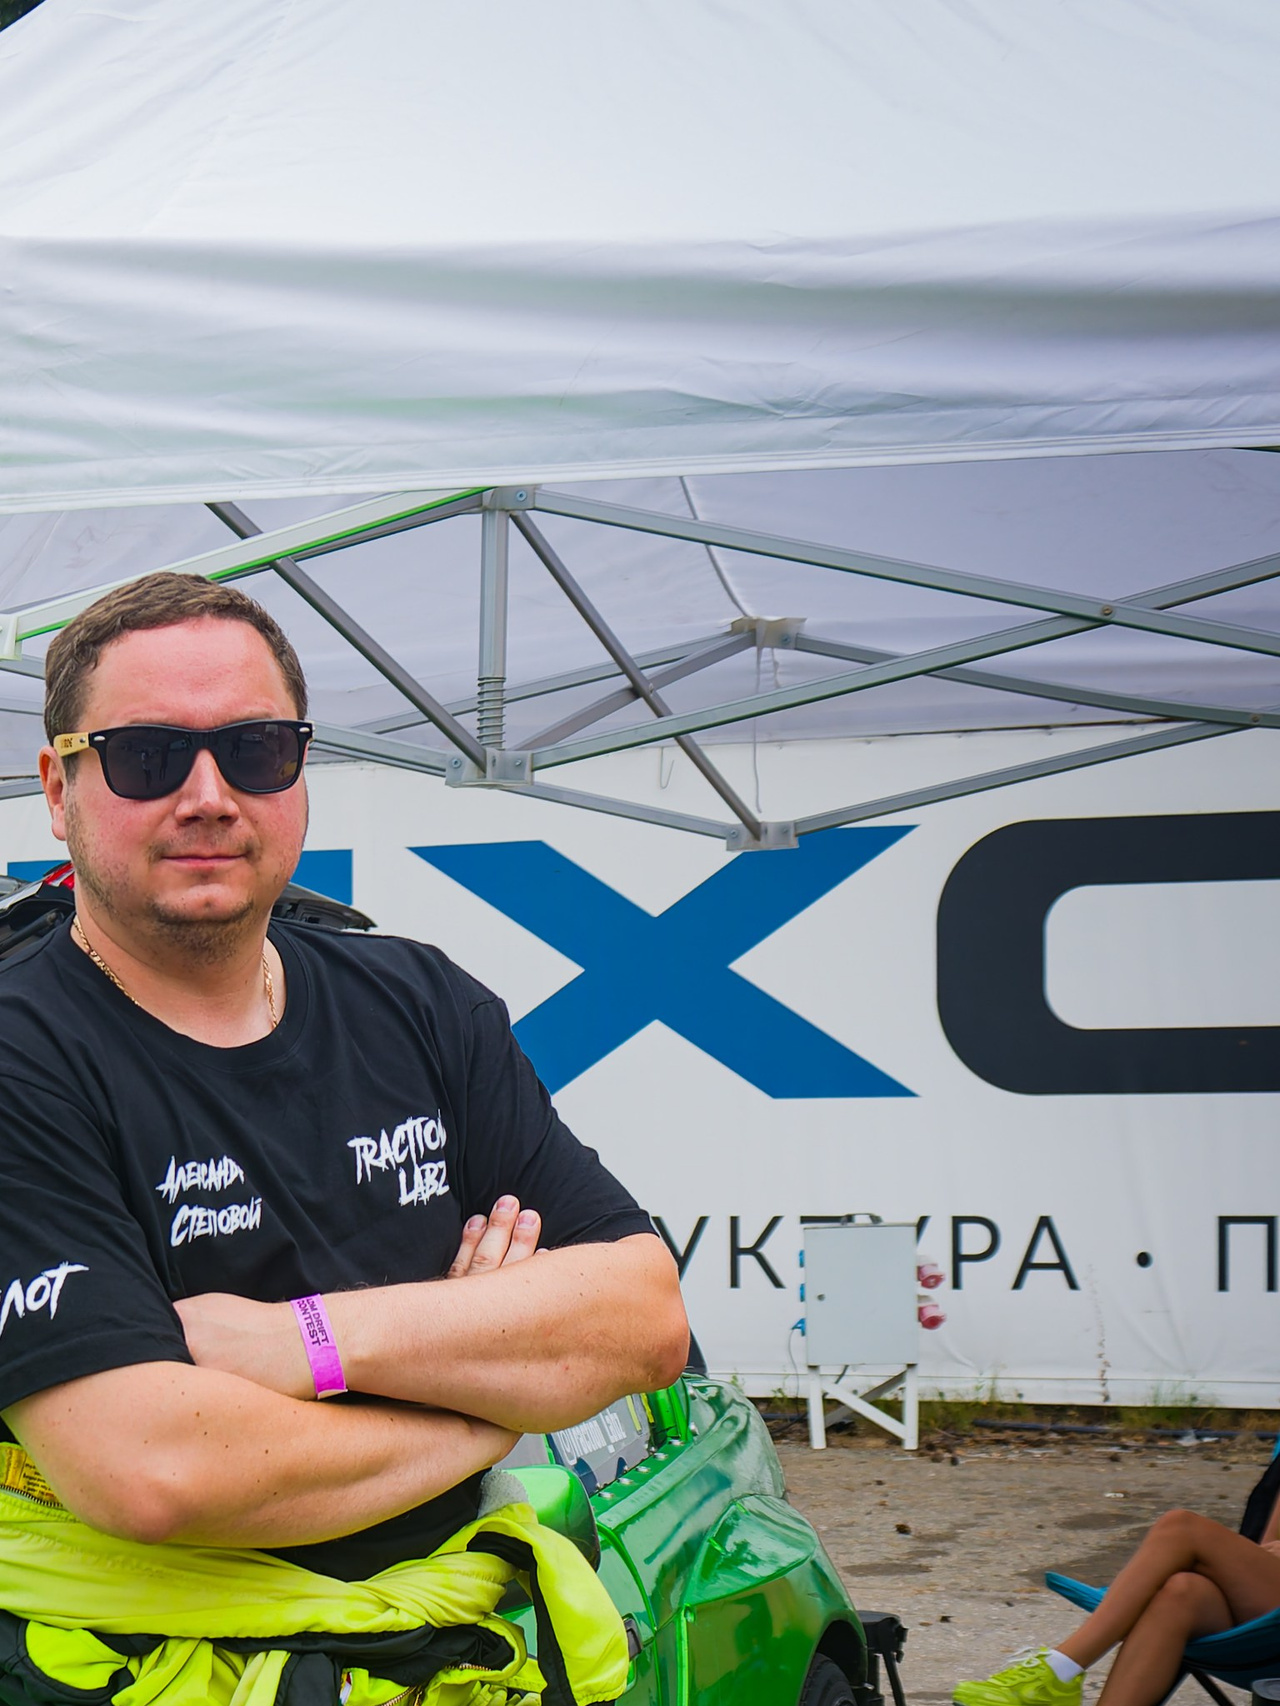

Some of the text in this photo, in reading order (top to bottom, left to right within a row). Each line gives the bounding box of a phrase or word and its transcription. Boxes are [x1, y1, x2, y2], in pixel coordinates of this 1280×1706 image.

[398, 1160, 450, 1207] LABZ
[170, 1196, 263, 1247] СТЕПОВОЙ
[652, 1215, 1080, 1291] УКРА
[313, 1312, 330, 1344] DRIFT
